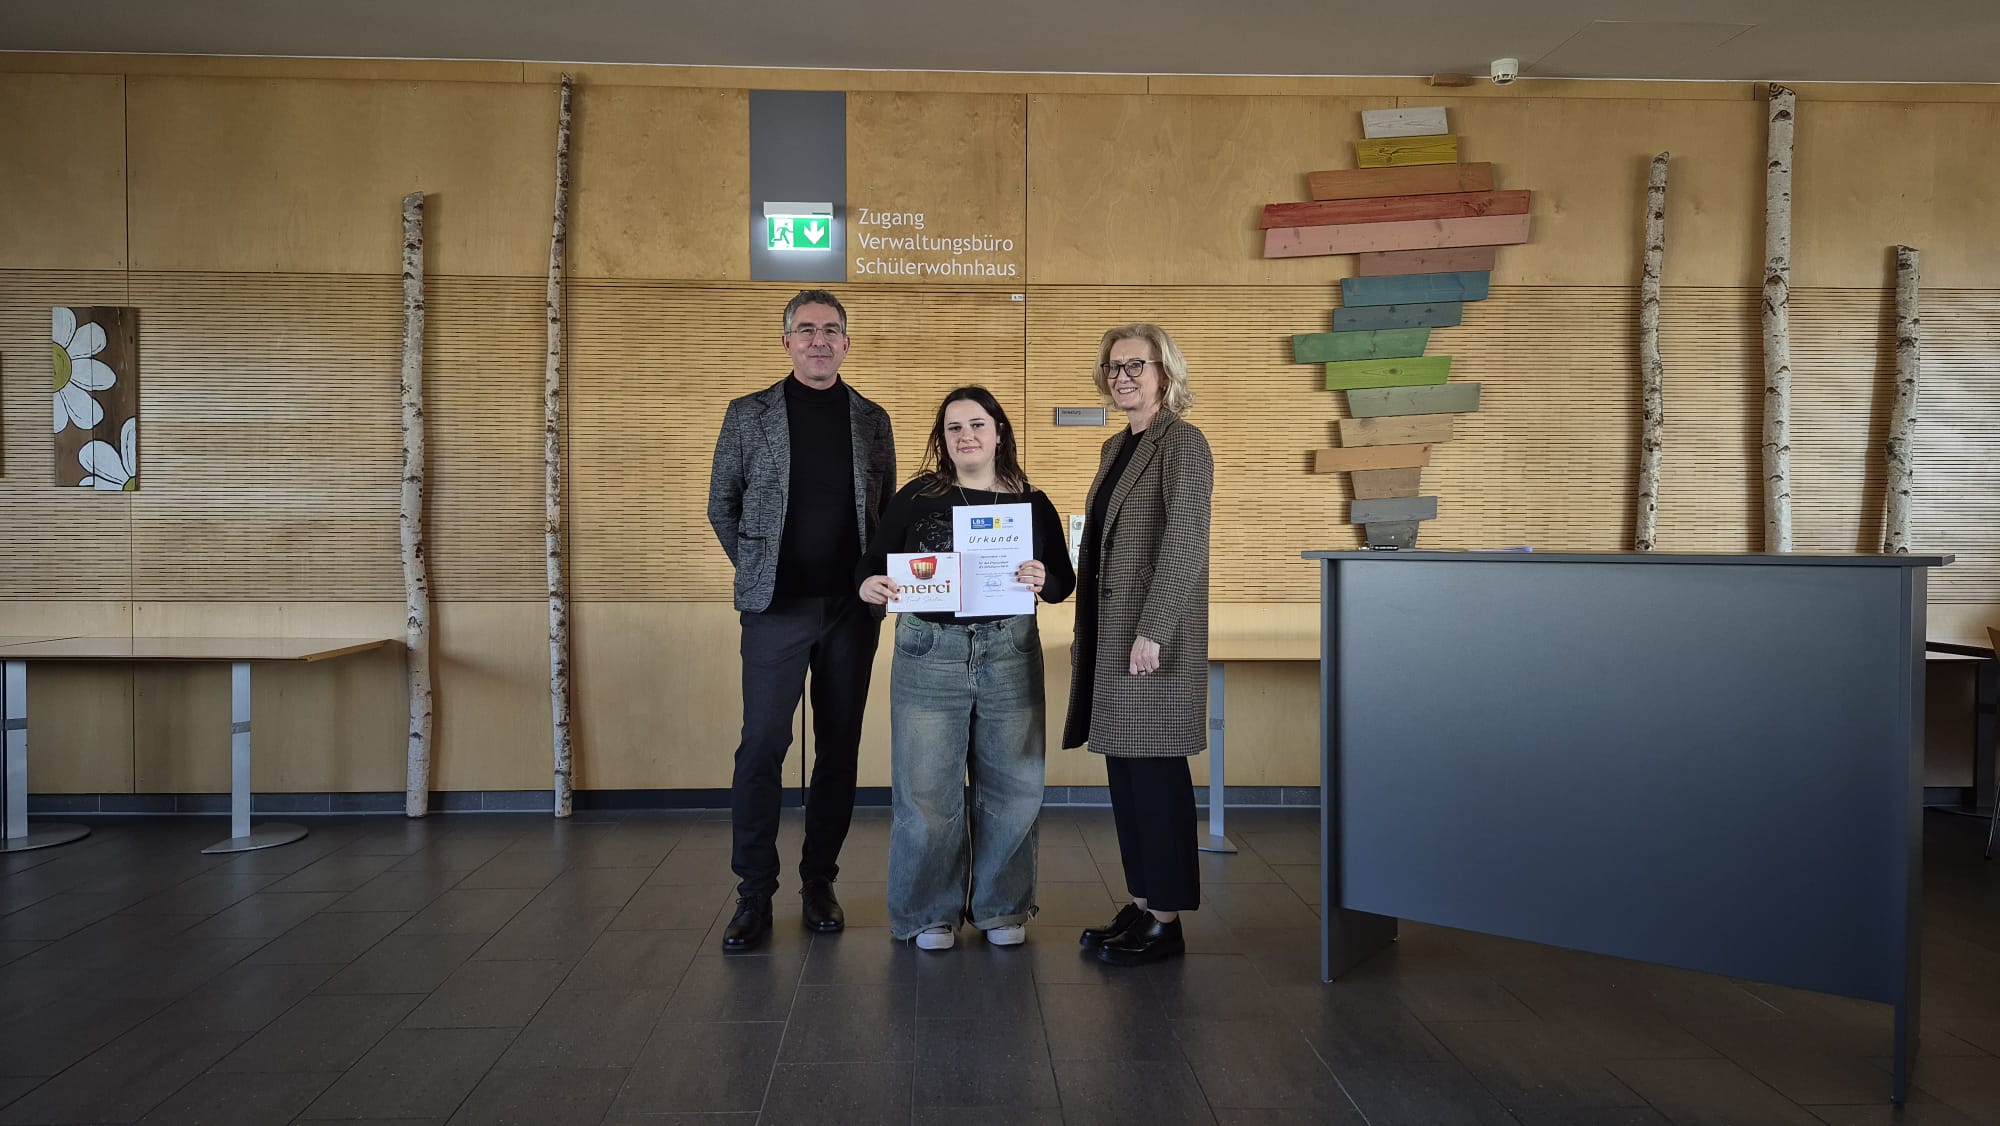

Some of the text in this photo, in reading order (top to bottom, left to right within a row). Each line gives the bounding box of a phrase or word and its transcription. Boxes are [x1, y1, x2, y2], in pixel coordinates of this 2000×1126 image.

[858, 207, 925, 229] Zugang
[858, 233, 1014, 255] Verwaltungsbüro
[855, 257, 1016, 276] Schülerwohnhaus
[968, 535, 1019, 544] Urkunde
[899, 580, 951, 594] merci
